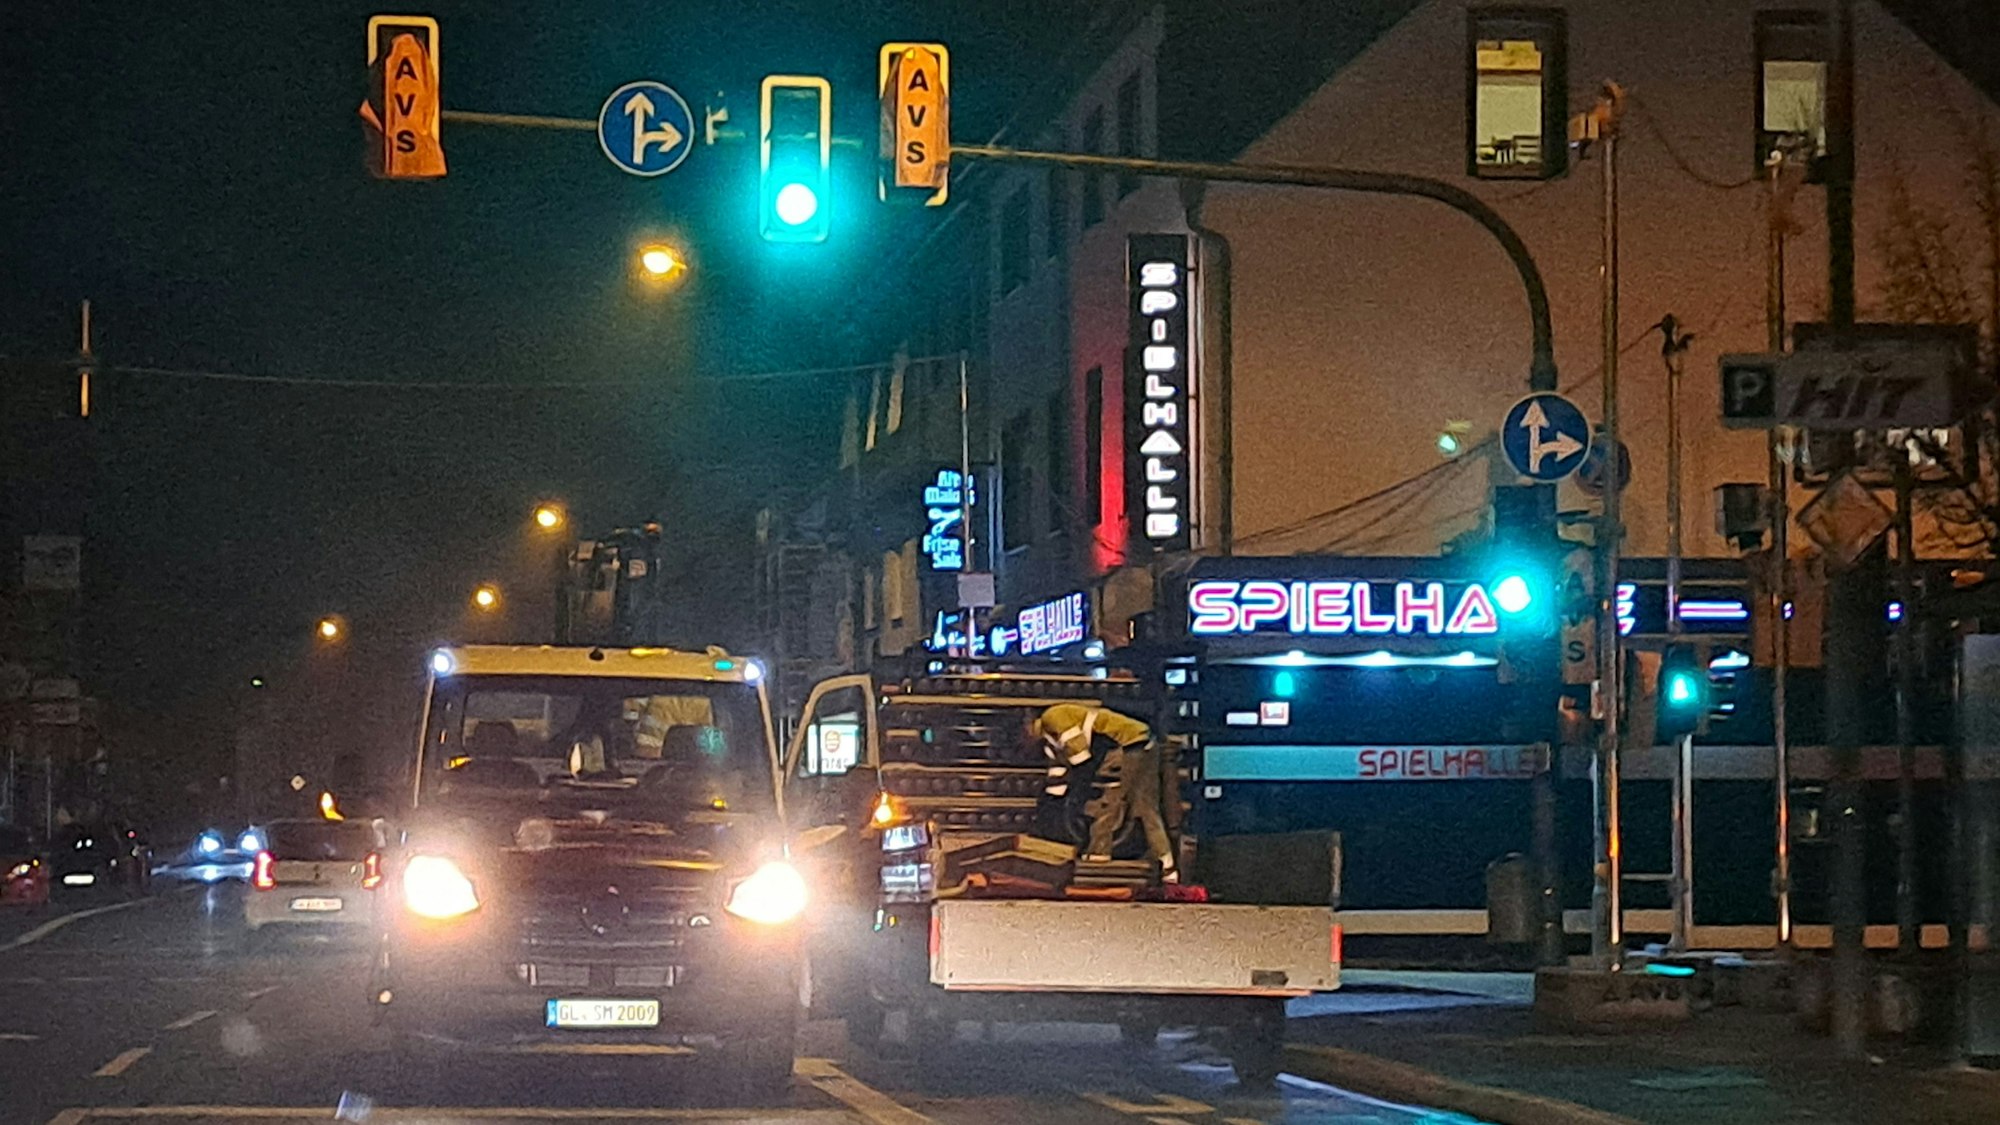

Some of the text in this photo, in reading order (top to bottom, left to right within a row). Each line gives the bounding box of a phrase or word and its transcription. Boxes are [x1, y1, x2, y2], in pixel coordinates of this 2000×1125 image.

[395, 57, 417, 152] AVS
[906, 68, 929, 163] AVS
[1140, 262, 1181, 536] SPIELHALLE
[1190, 582, 1635, 636] SPIELHA
[617, 1004, 656, 1021] 2009
